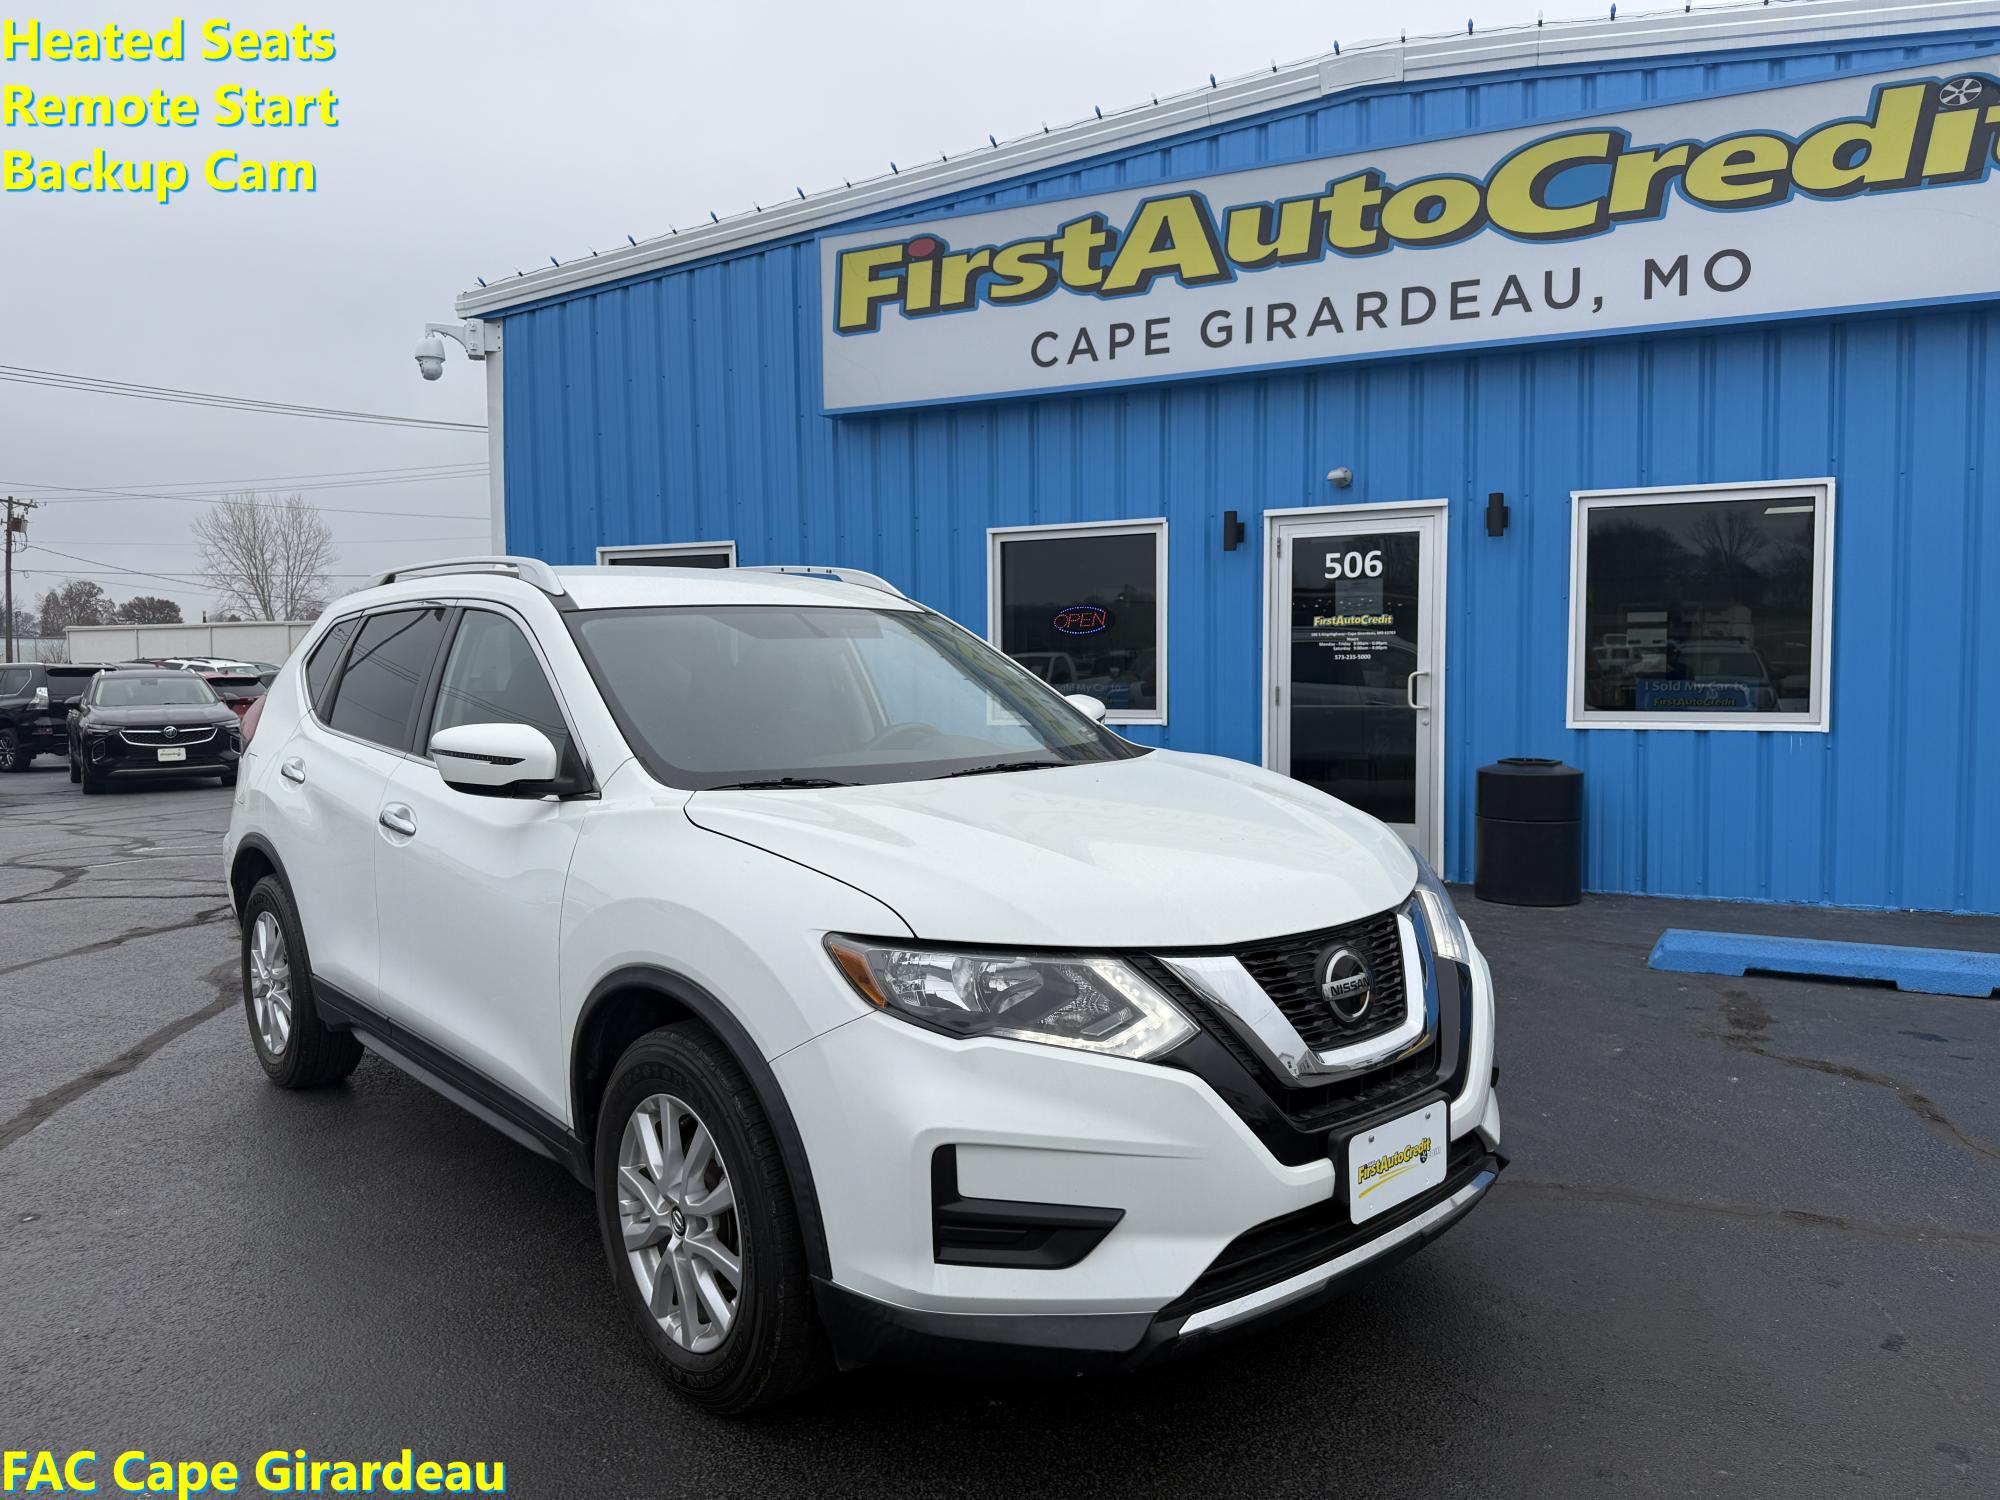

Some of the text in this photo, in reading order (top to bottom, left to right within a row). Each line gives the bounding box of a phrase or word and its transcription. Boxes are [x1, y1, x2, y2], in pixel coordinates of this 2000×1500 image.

[1030, 248, 1752, 368] CAPE GIRARDEAU, MO
[1324, 550, 1384, 579] 506
[1053, 611, 1108, 629] OPEN
[1313, 614, 1393, 627] FirstAutoCredit
[1652, 681, 1681, 691] Sold
[1684, 682, 1704, 693] My
[1330, 977, 1369, 997] NISSAN
[1358, 1137, 1431, 1184] FirstAutoCredit
